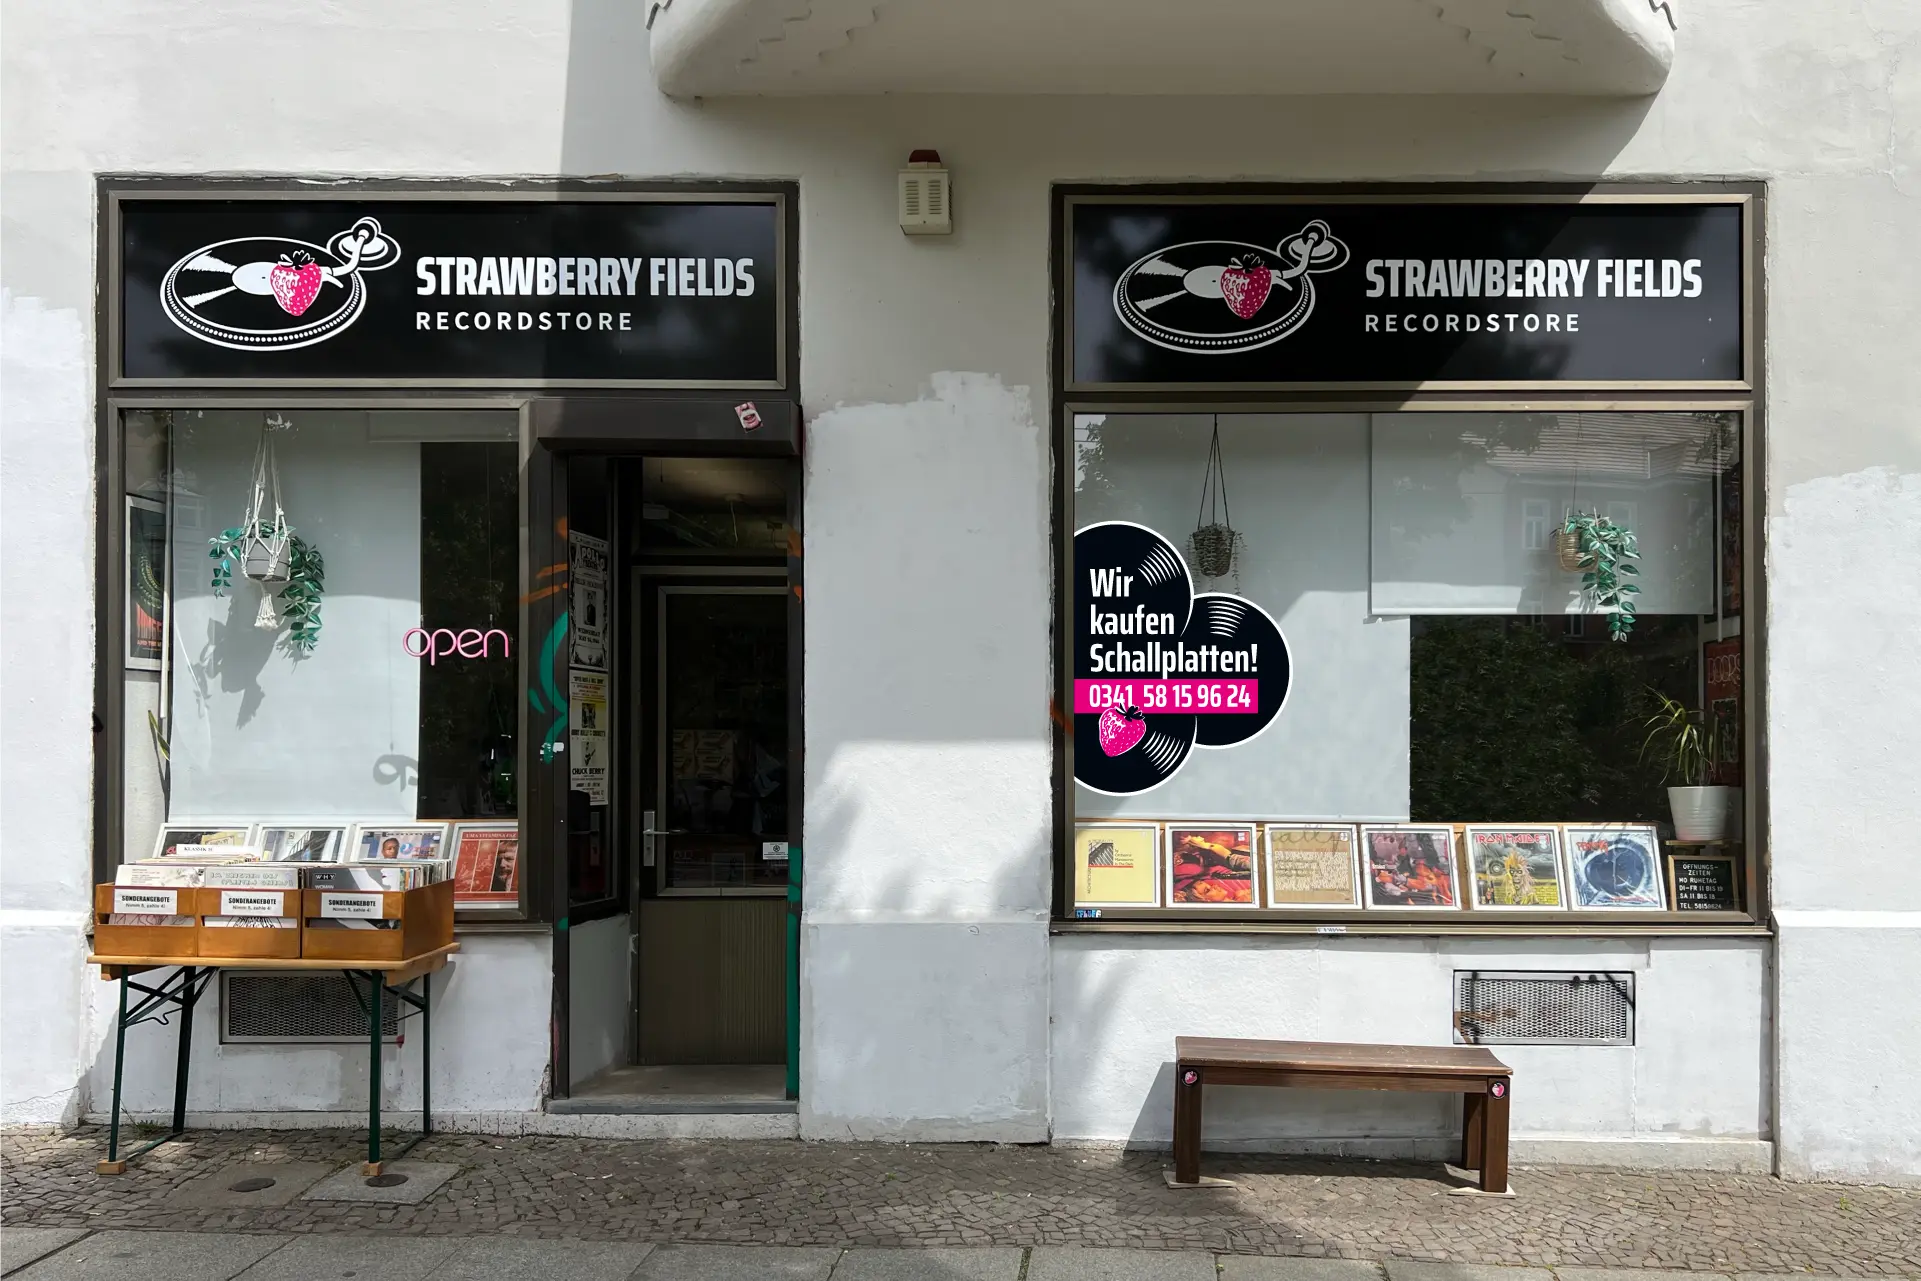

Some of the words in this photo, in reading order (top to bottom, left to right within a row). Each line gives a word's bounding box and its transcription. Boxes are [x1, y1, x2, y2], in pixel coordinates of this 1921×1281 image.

[416, 256, 641, 297] STRAWBERRY
[649, 256, 756, 297] FIELDS
[1365, 258, 1589, 298] STRAWBERRY
[1597, 258, 1703, 299] FIELDS
[415, 311, 633, 331] RECORDSTORE
[1365, 313, 1580, 333] RECORDSTORE
[1090, 566, 1134, 597] Wir
[1090, 604, 1175, 635] kaufen
[403, 628, 509, 666] open
[1090, 641, 1258, 680] Schallplatten!
[1089, 684, 1133, 708] 0341
[1143, 684, 1168, 708] 58
[1172, 684, 1192, 708] 15
[1197, 684, 1222, 708] 96
[1227, 684, 1251, 708] 24
[1475, 833, 1503, 843] IRON
[121, 895, 170, 903] SONDERANGEBOTE
[228, 897, 276, 905] SONDERANGEBOTE
[328, 899, 376, 907] SONDERANGEBOTE
